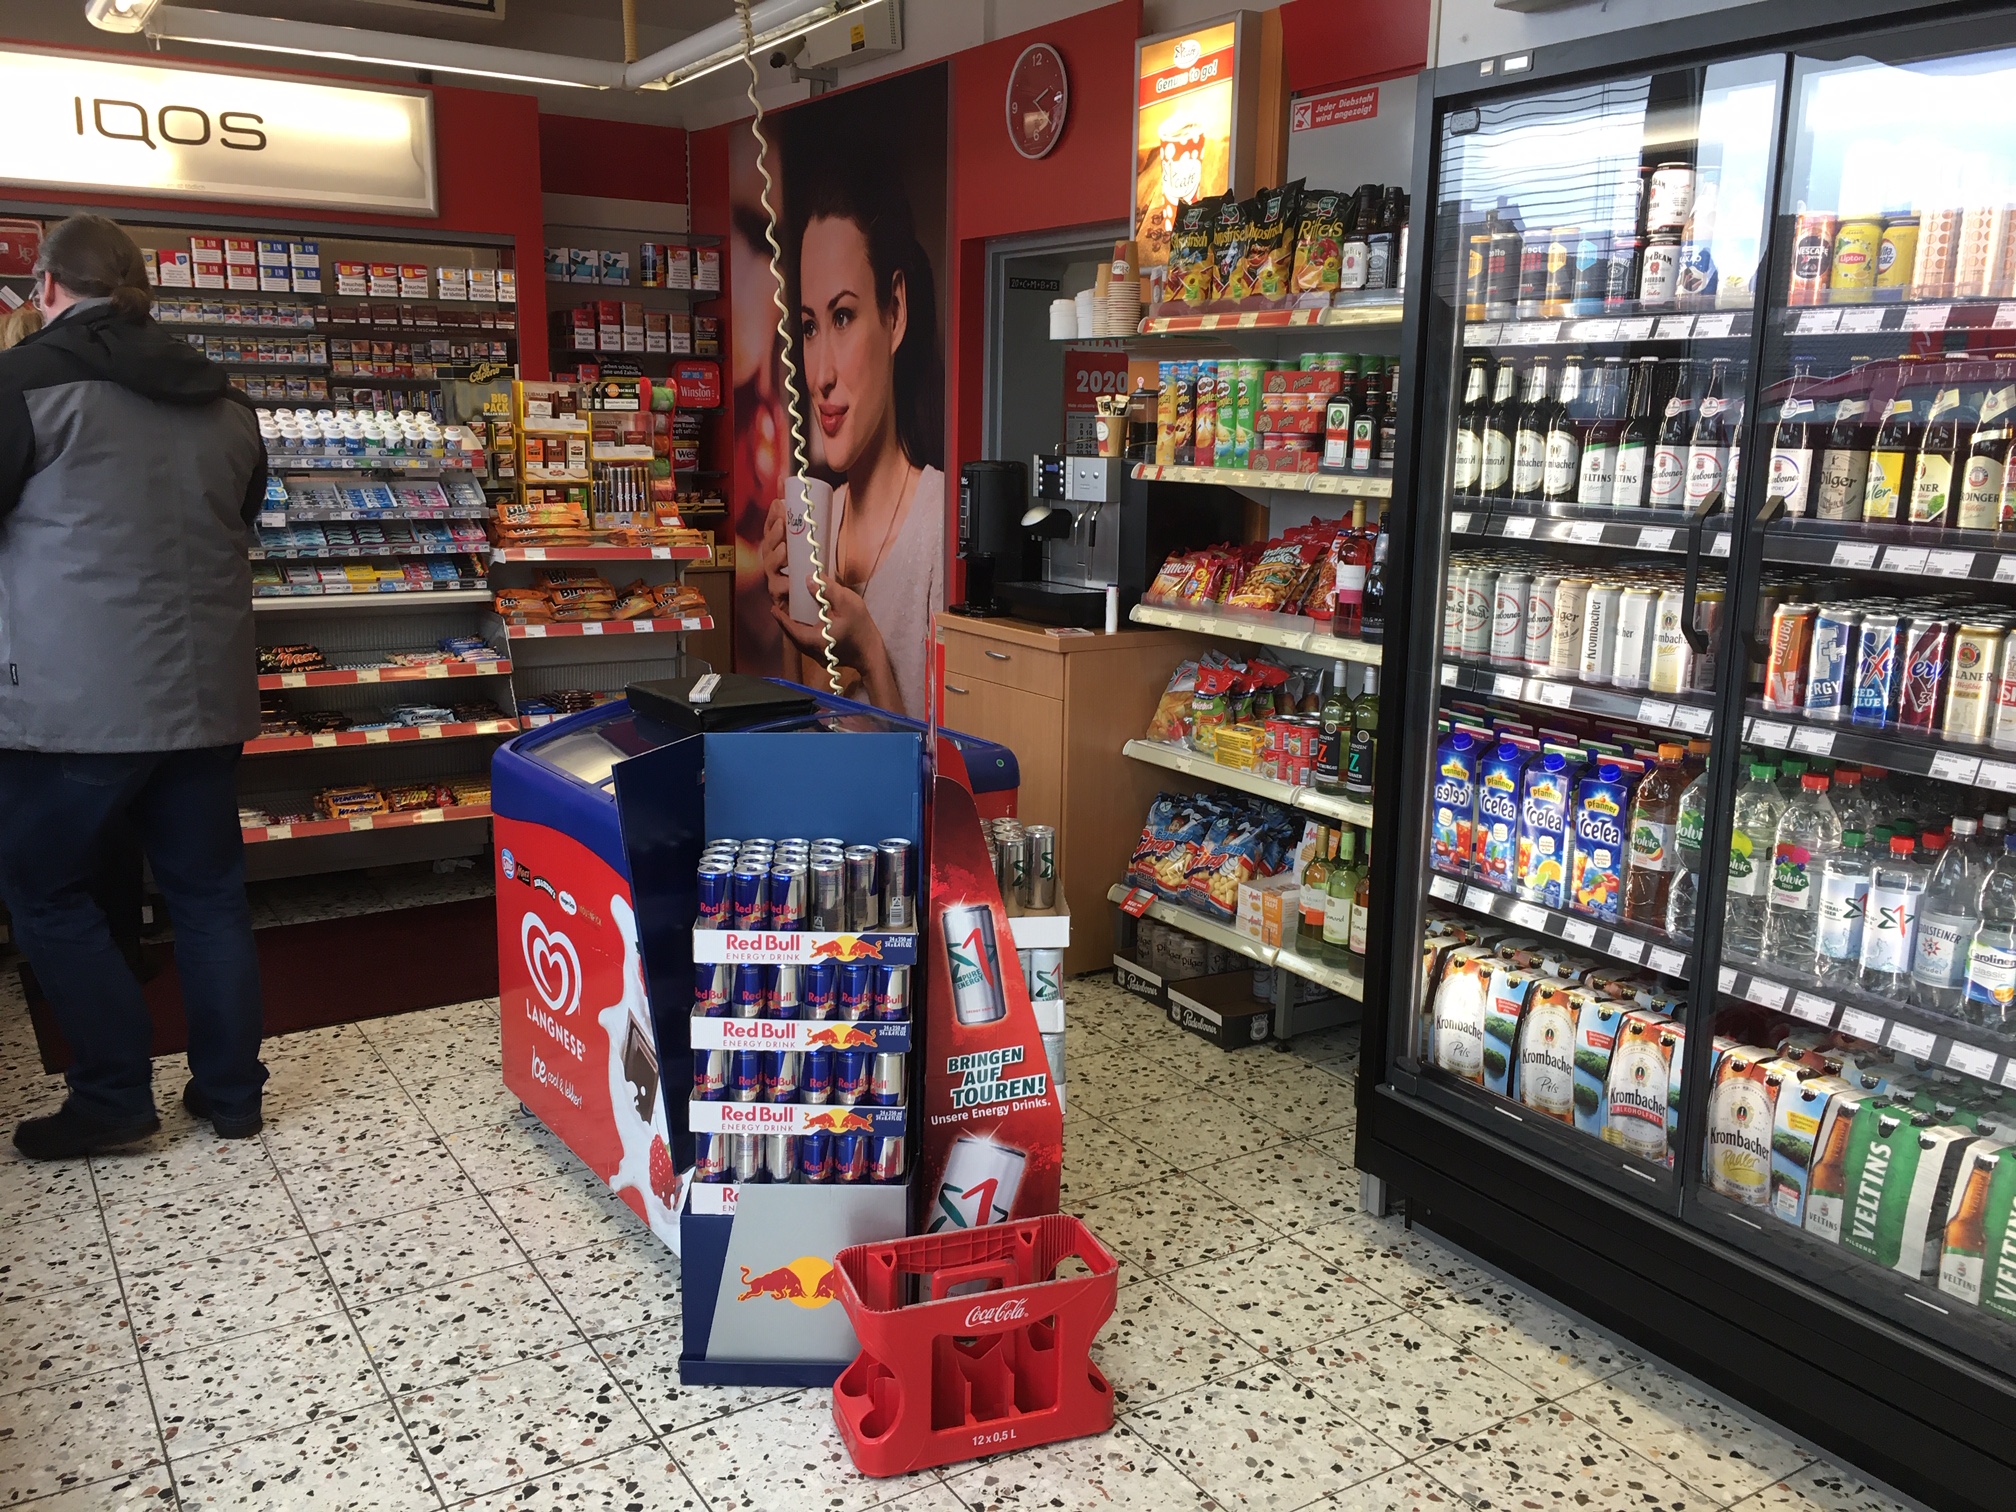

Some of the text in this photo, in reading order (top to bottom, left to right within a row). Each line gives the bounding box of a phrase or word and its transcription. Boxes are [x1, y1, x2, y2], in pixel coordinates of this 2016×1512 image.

[1032, 53, 1042, 67] 12
[1190, 60, 1218, 81] to go!
[1011, 102, 1018, 114] 9
[1316, 92, 1375, 113] Jeder Diebstahl
[1316, 104, 1373, 123] wird angezeigt
[75, 96, 268, 151] IQOS
[1033, 128, 1040, 142] 6
[1298, 216, 1344, 239] Riffels
[1839, 254, 1865, 263] Lipton
[1077, 370, 1128, 393] 2020
[491, 393, 508, 403] BIG
[681, 385, 711, 398] Winston
[483, 402, 509, 413] PACK
[1586, 599, 1602, 660] Krombacher
[1773, 619, 1795, 666] CURUBA
[1487, 776, 1513, 792] pfanner
[1532, 785, 1560, 801] pfanner
[1587, 798, 1618, 815] pfanner
[727, 934, 800, 951] Red Bull
[726, 953, 766, 961] ENERGY
[961, 968, 982, 981] PURE
[1974, 966, 2007, 980] classic
[957, 975, 984, 990] ENERGY
[742, 990, 760, 1001] Red
[808, 991, 828, 1002] Red
[842, 992, 861, 1003] Red
[526, 998, 583, 1062] LANGNESE
[723, 1022, 796, 1039] Red Bull
[1436, 1015, 1483, 1042] Krombacher
[723, 1040, 762, 1048] ENERGY
[1449, 1041, 1470, 1058] Pils
[948, 1046, 1023, 1073] BRINGEN
[1522, 1048, 1573, 1077] Krombacher
[705, 1073, 722, 1084] Bull
[739, 1075, 757, 1086] Red
[810, 1078, 828, 1088] Red
[838, 1078, 856, 1089] Red
[963, 1066, 1001, 1087] AUF
[1536, 1076, 1559, 1094] Pils
[952, 1075, 1046, 1107] TOUREN!
[1610, 1088, 1666, 1118] Krombacher
[722, 1105, 794, 1123] Red Bull
[931, 1098, 1052, 1126] Unsere Energy Drinks.
[1616, 1106, 1661, 1123] ALKOHOLFREI
[721, 1123, 794, 1132] ENERGY DRINK
[1710, 1126, 1769, 1160] Krombacher
[1721, 1149, 1759, 1172] Radler
[1852, 1140, 1892, 1241] VELTINS
[1808, 1212, 1838, 1232] VELTINS
[1844, 1237, 1877, 1256] PILSENER
[1943, 1272, 1977, 1294] VELTINS
[965, 1298, 1029, 1328] Coca-Cola
[972, 1429, 1017, 1446] 12 x 0,5 L
